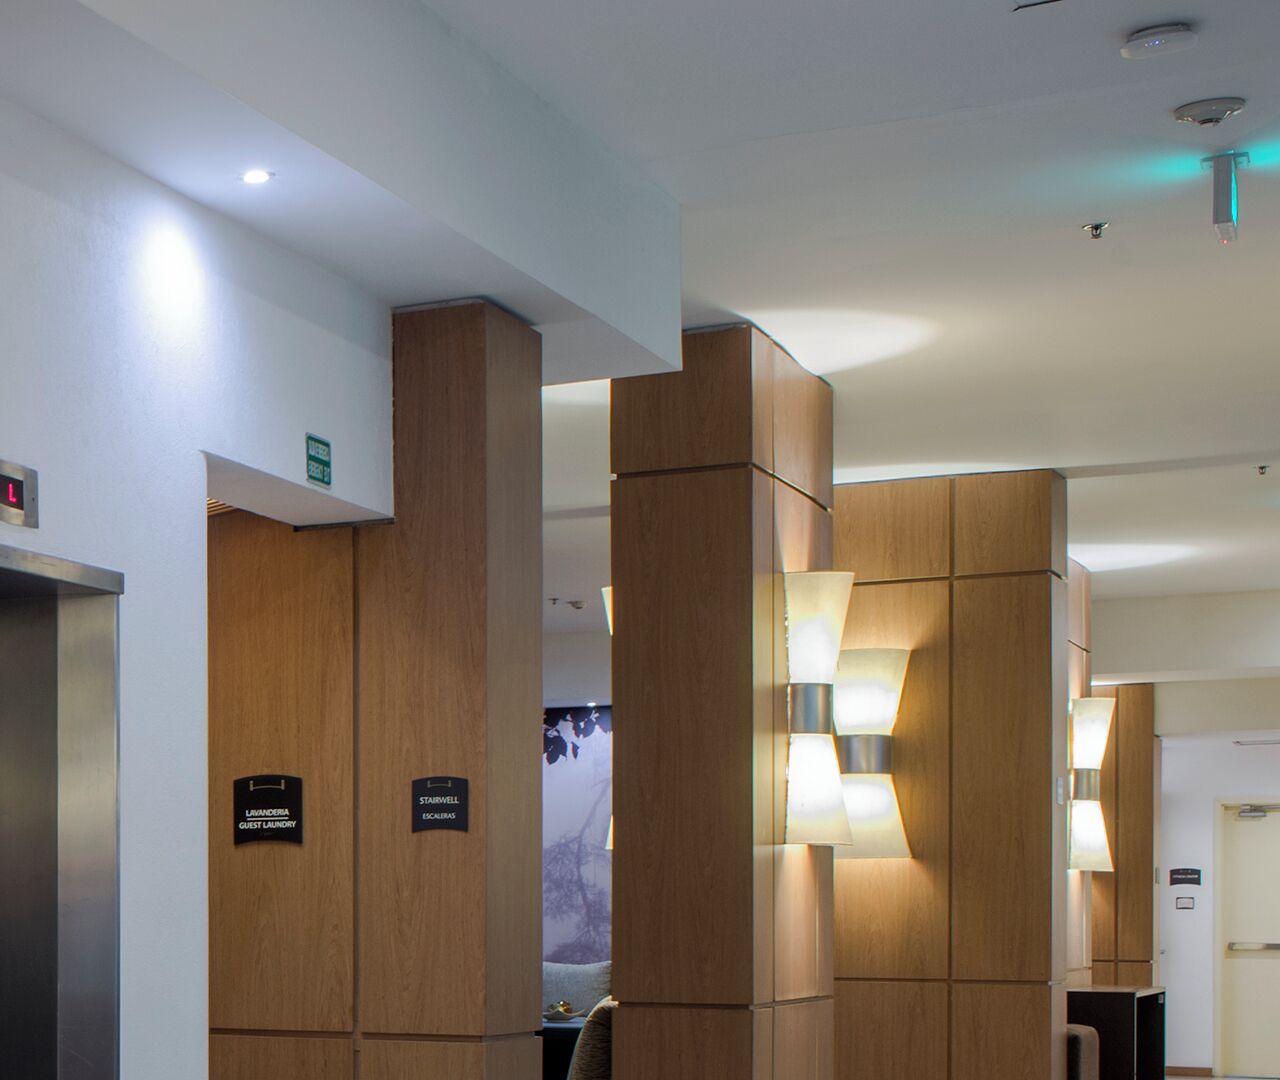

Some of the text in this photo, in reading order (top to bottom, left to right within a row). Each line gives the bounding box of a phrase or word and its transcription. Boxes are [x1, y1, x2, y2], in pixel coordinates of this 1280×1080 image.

[8, 482, 17, 503] L
[420, 796, 459, 804] STAIRWELL
[245, 808, 289, 817] LAVANDERIA
[422, 812, 456, 820] ESCALERAS
[239, 820, 296, 829] GUEST LAUNDRY
